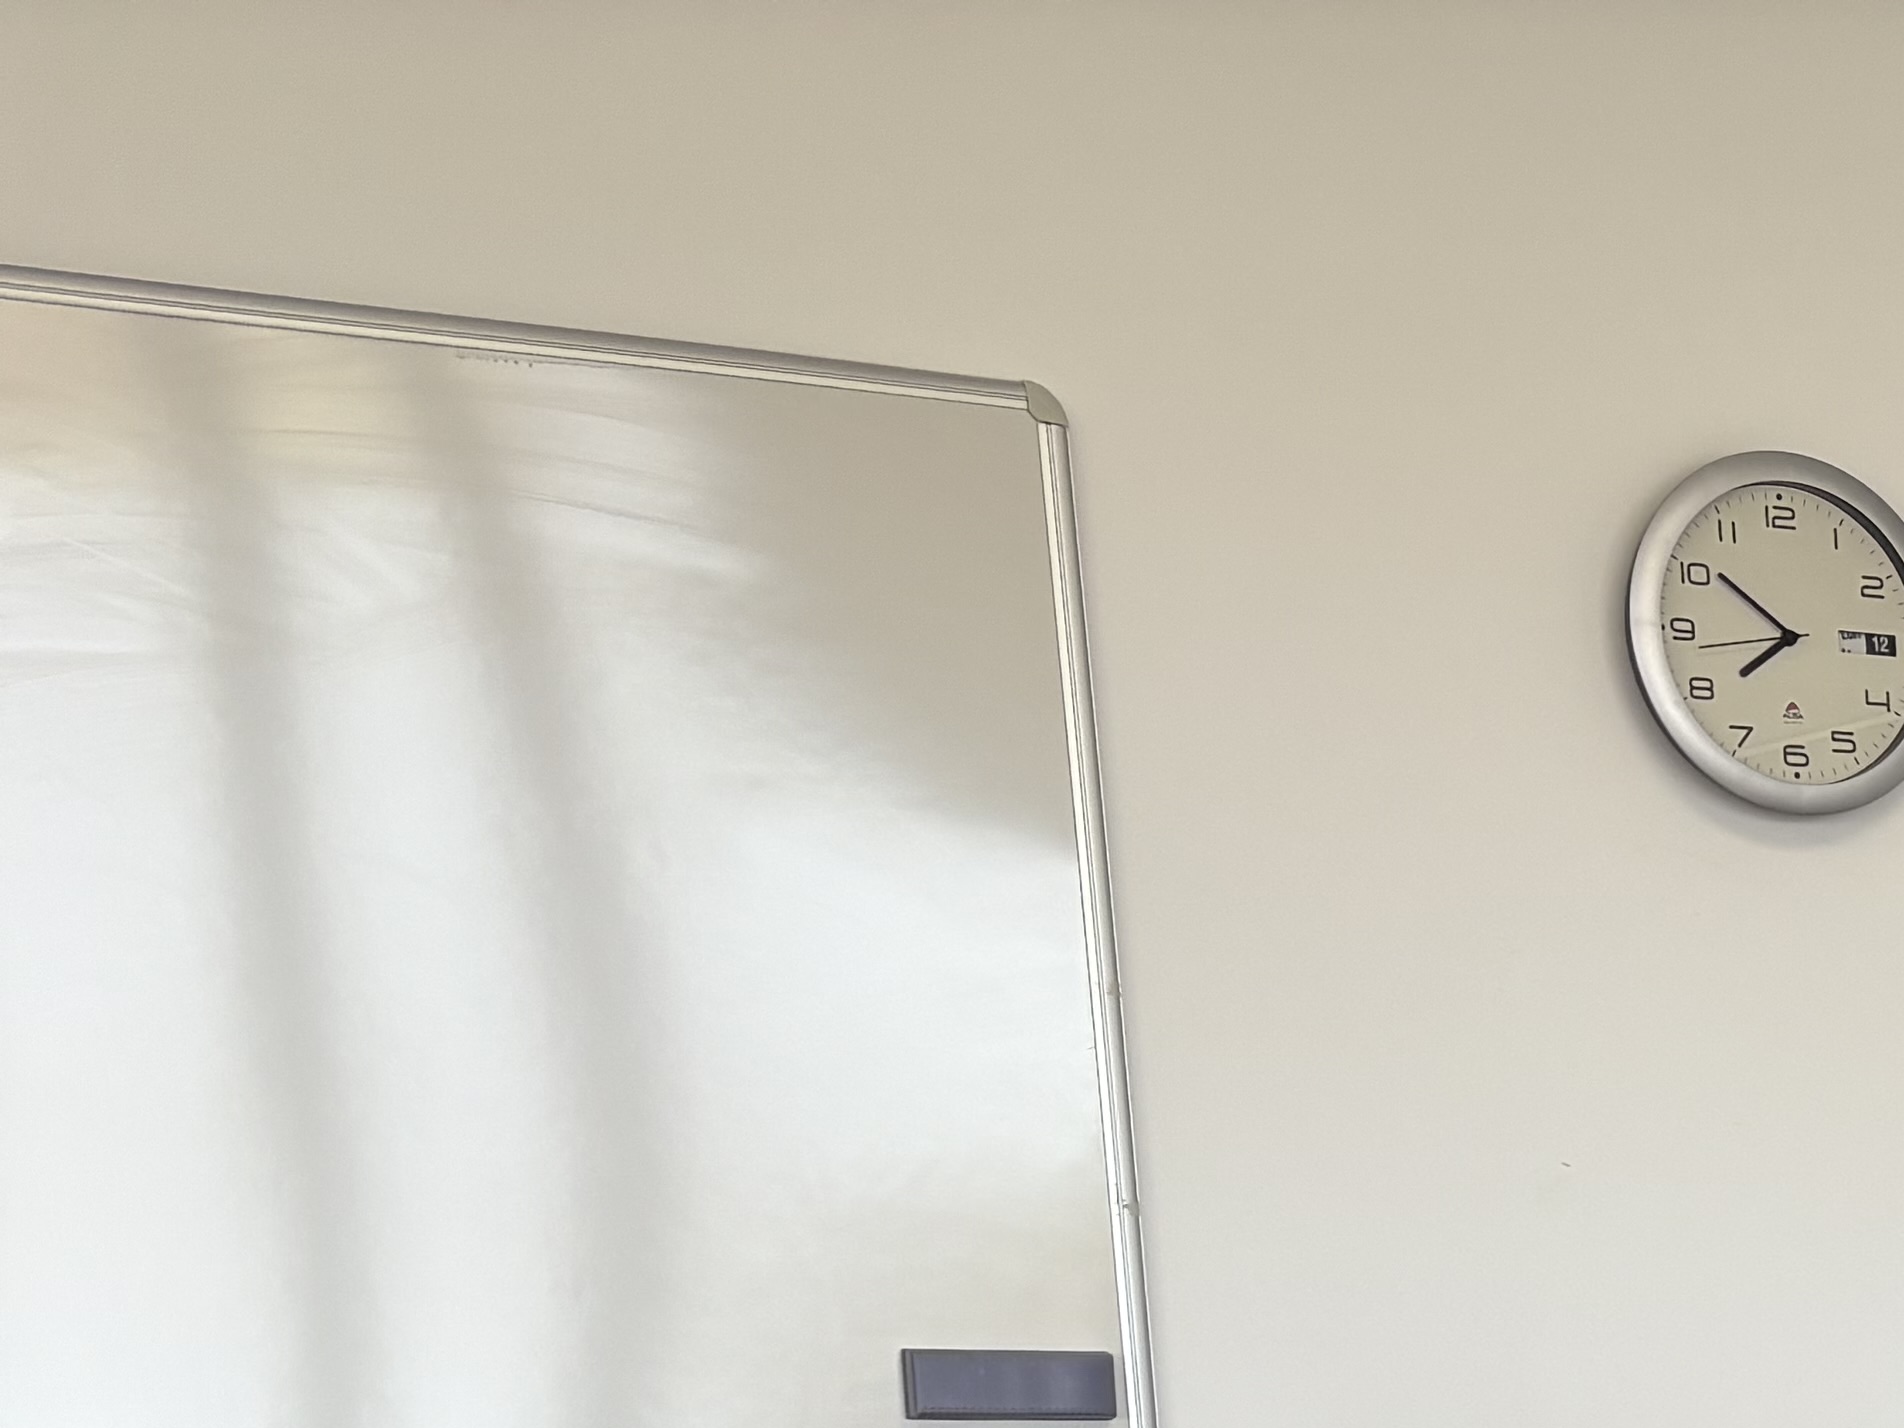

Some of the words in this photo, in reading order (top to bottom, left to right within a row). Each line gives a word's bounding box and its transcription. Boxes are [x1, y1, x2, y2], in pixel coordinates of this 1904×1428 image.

[1764, 504, 1797, 531] 12
[1717, 519, 1736, 544] 11
[1833, 527, 1839, 550] 1
[1679, 560, 1711, 586] 10
[1860, 574, 1886, 600] 2
[1669, 617, 1696, 641] 9
[1871, 635, 1890, 652] 12
[1688, 676, 1715, 700] 8
[1864, 688, 1892, 713] 4
[1728, 724, 1754, 749] 7
[1830, 730, 1857, 754] 5
[1782, 744, 1810, 768] 6
